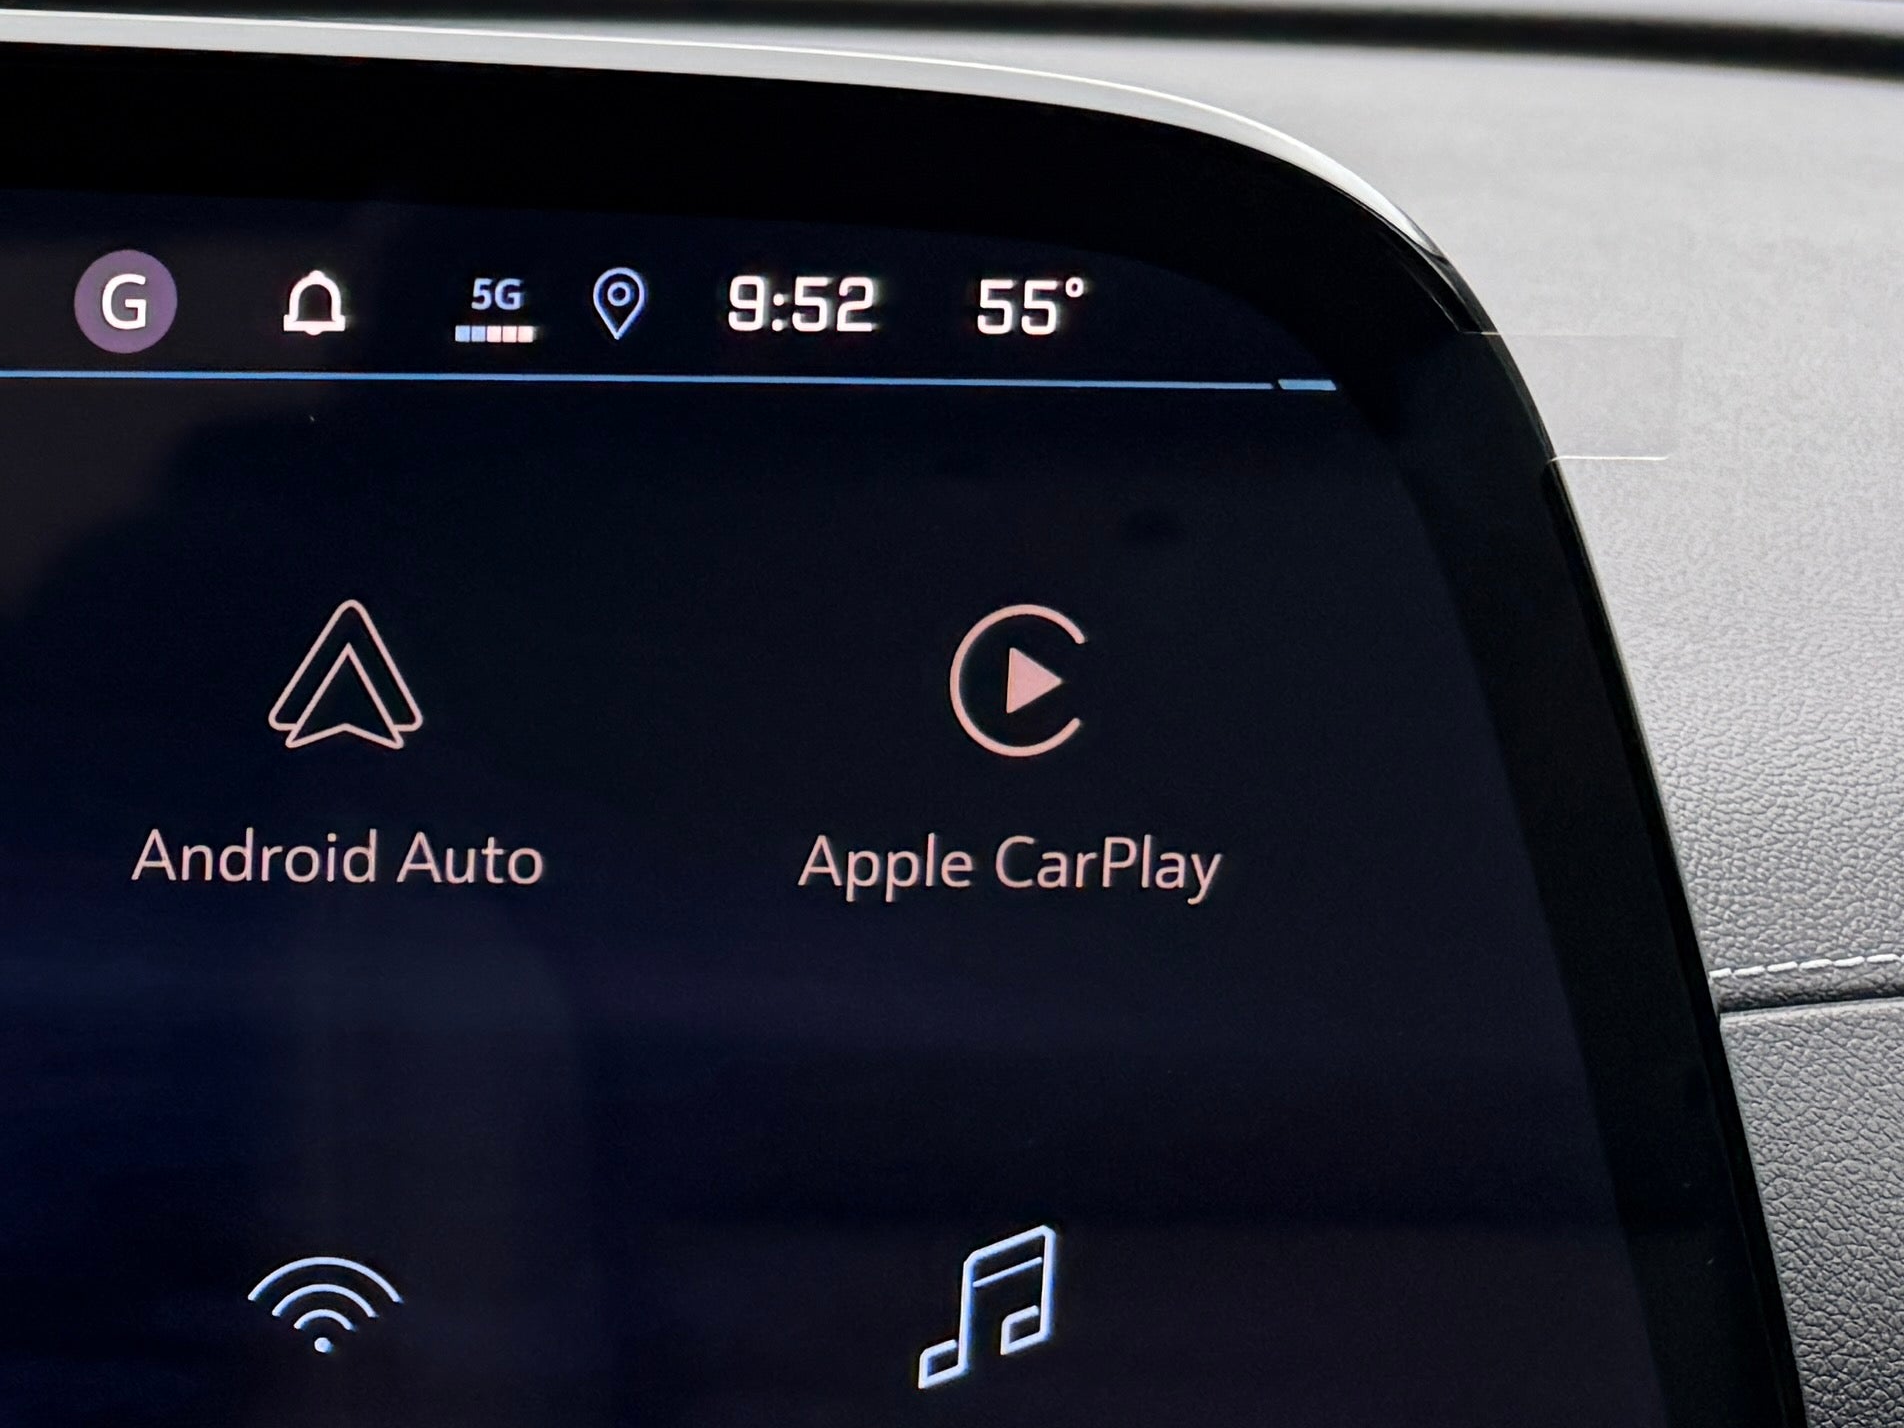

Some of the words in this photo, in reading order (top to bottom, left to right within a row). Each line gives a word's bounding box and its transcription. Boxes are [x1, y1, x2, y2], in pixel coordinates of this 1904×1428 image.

[101, 272, 148, 331] G
[471, 277, 524, 312] 5G
[727, 274, 878, 333] 9:52
[976, 275, 1086, 337] 55°
[130, 826, 378, 884] Android
[395, 830, 544, 886] Auto
[796, 831, 974, 904] Apple
[994, 833, 1223, 906] CarPlay
